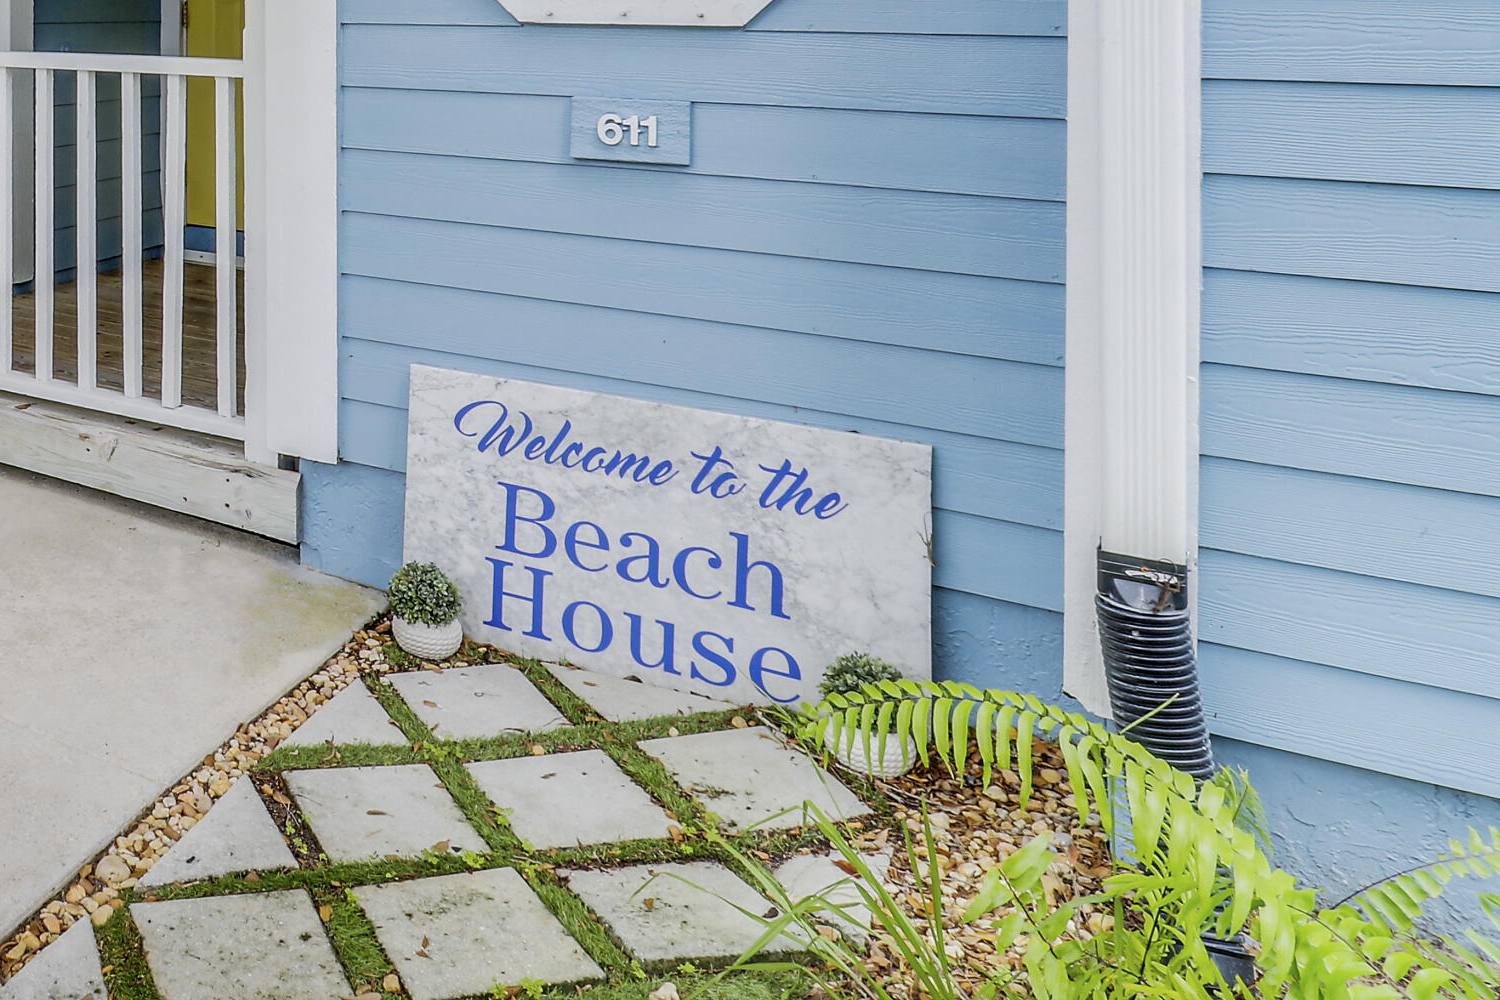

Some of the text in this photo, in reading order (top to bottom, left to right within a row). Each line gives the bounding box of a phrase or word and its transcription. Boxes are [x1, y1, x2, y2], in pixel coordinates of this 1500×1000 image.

[597, 113, 658, 147] 611
[454, 400, 849, 520] Welcome to the
[495, 482, 791, 620] Beach
[483, 556, 801, 704] House
